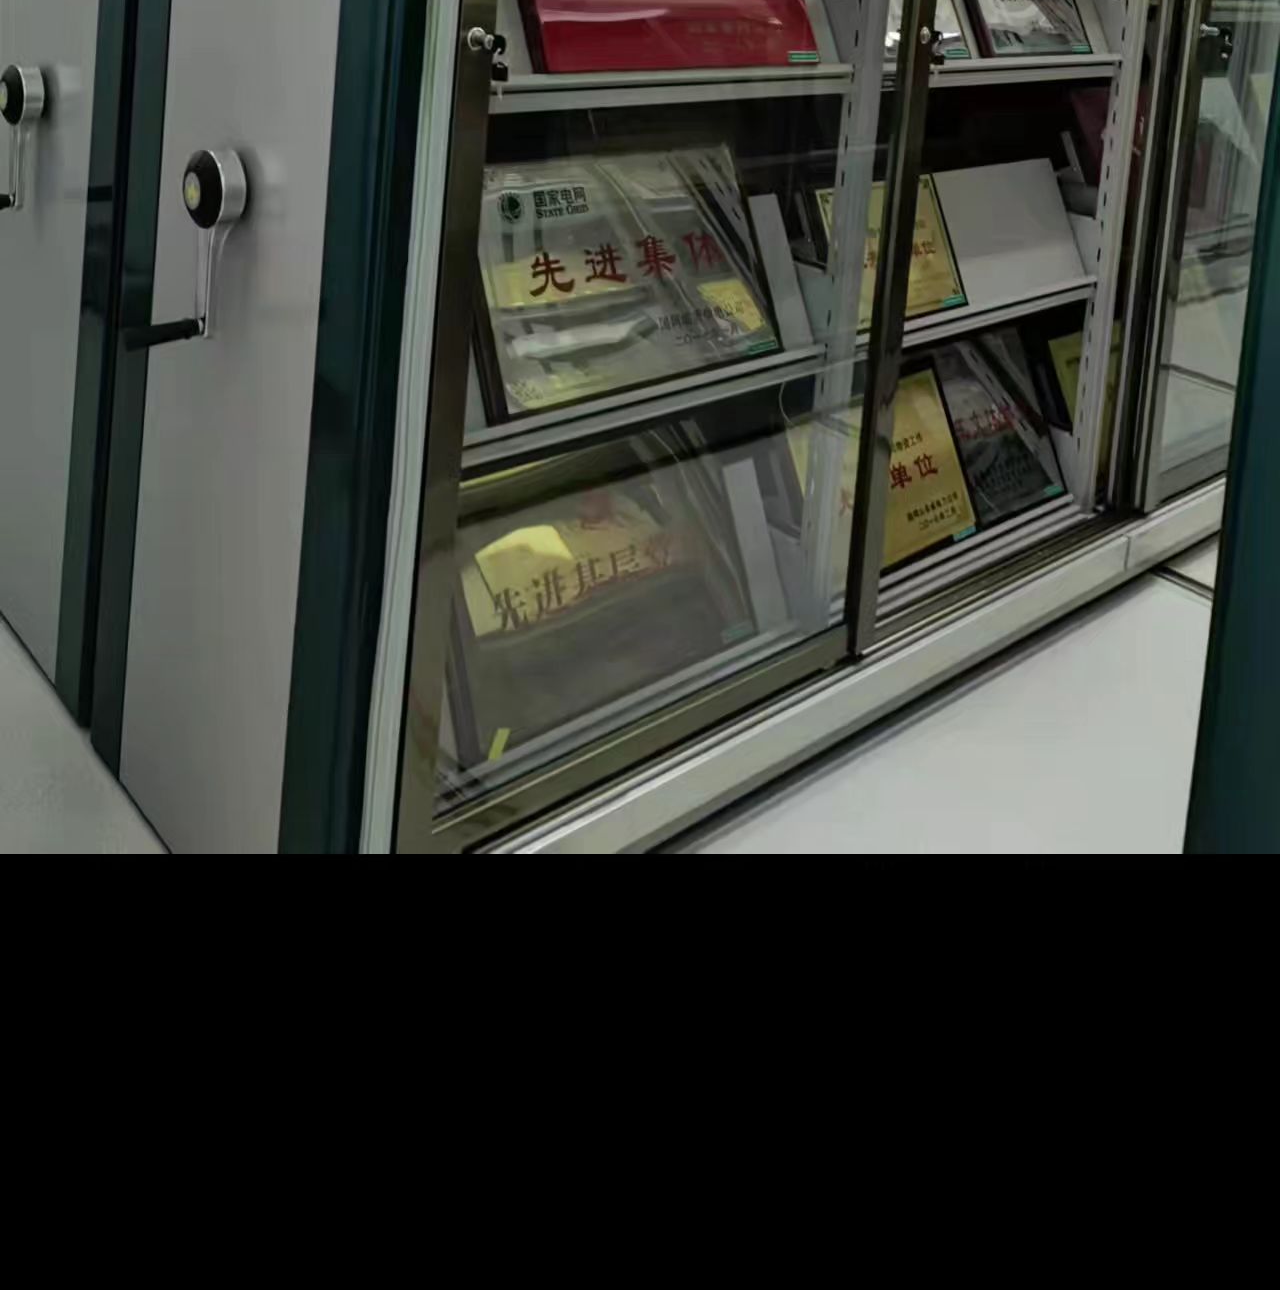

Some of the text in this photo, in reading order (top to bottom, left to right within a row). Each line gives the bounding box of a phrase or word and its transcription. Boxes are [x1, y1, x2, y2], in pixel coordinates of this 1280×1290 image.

[533, 186, 587, 207] 国家电网
[535, 207, 564, 219] STATE
[530, 230, 727, 298] 先进集体
[889, 453, 938, 489] 单位
